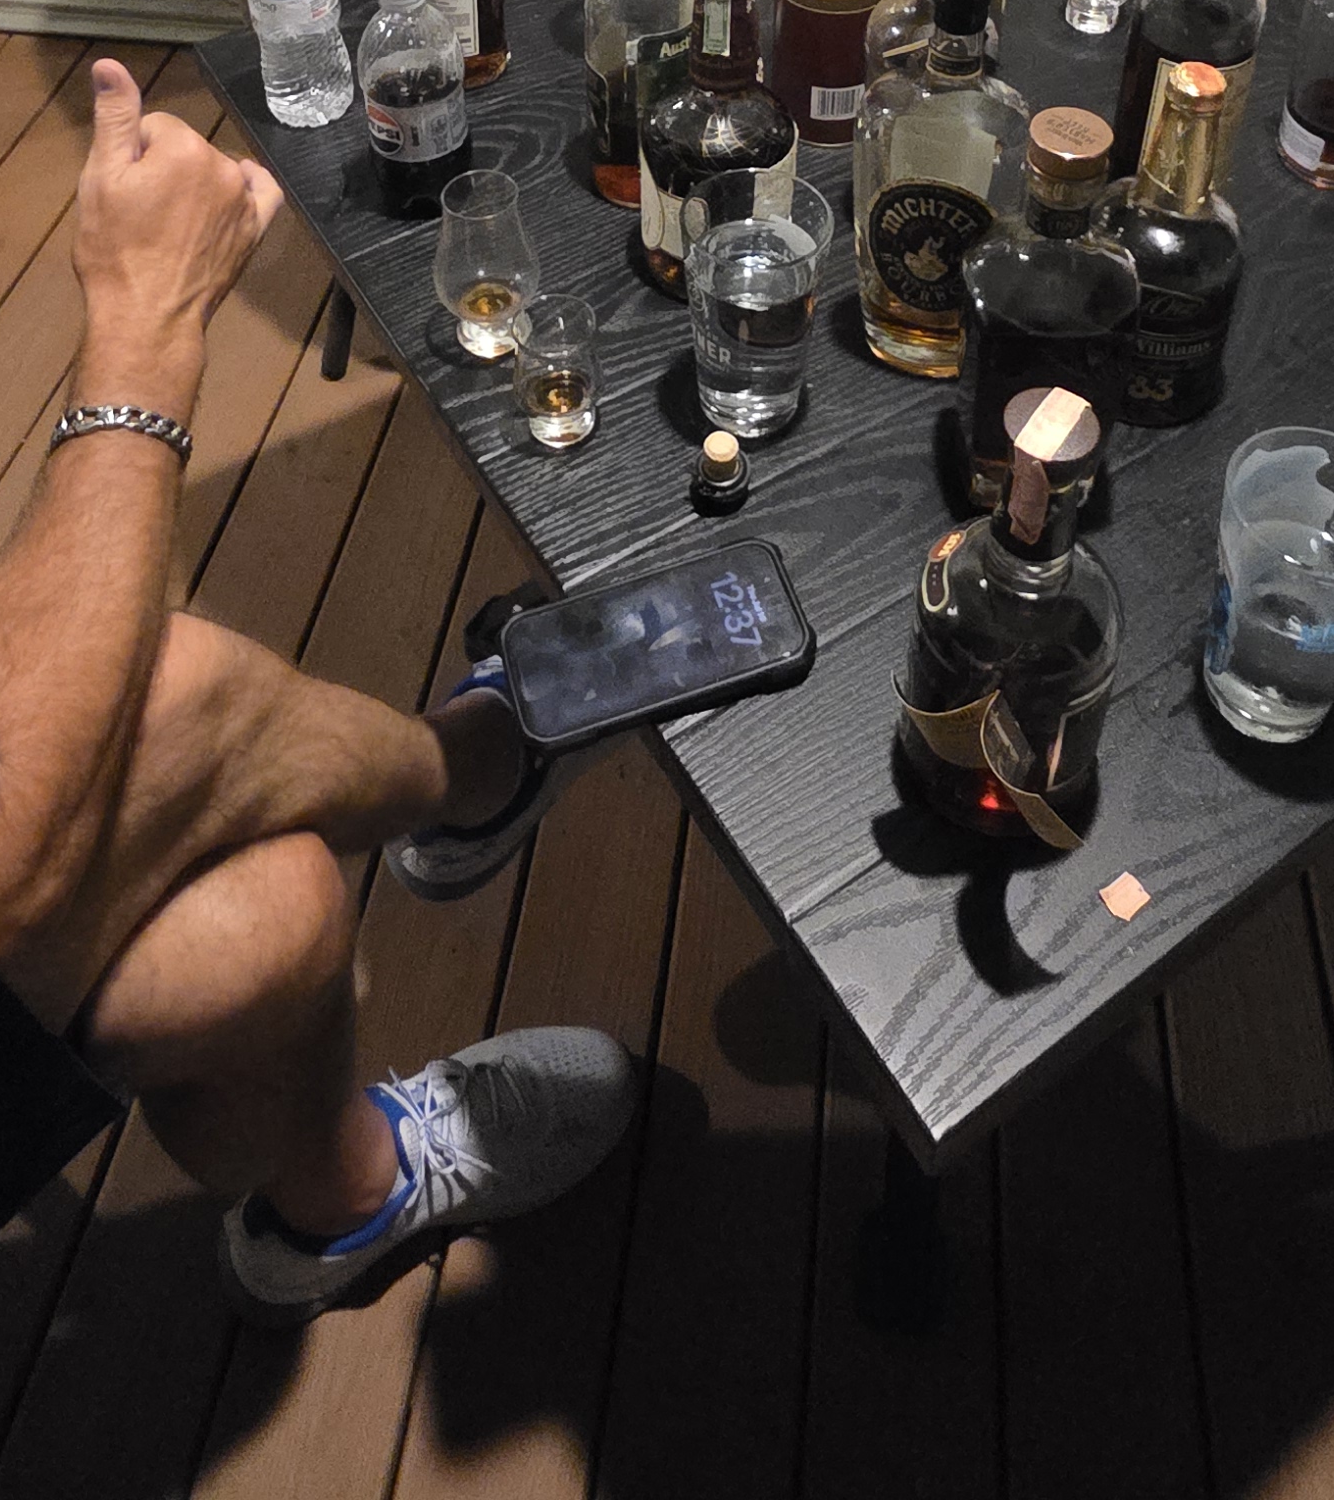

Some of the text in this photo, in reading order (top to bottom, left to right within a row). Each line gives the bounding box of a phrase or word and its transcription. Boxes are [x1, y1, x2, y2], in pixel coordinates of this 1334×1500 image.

[659, 33, 691, 59] Aust
[368, 118, 401, 141] EPSI
[880, 197, 978, 238] MICHTER
[710, 571, 763, 646] 12:37
